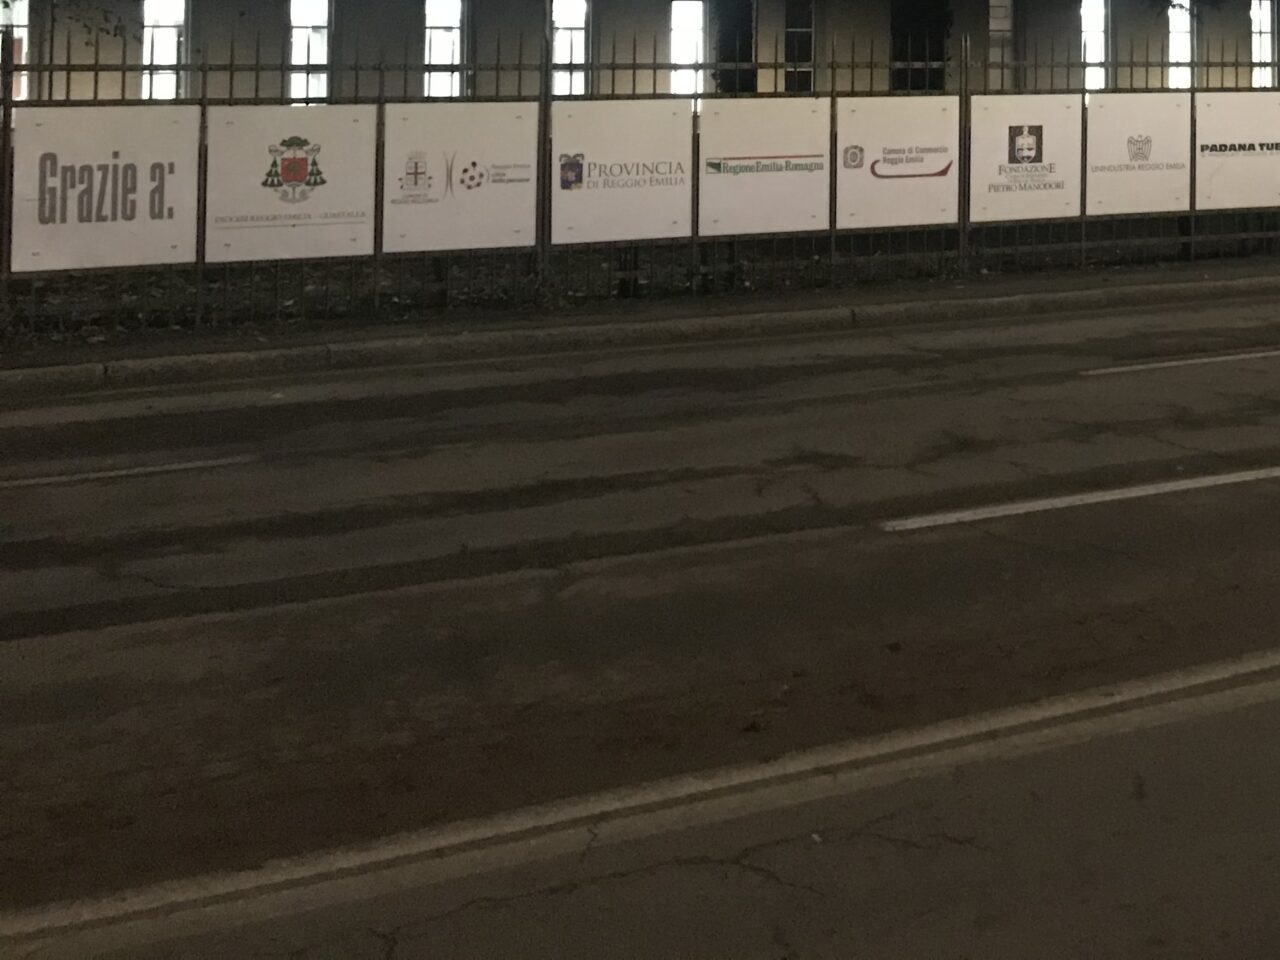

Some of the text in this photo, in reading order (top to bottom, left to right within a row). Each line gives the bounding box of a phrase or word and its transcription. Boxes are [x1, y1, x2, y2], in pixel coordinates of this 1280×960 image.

[1200, 143, 1256, 153] PADANA
[587, 161, 685, 178] PROVINCIA
[998, 162, 1056, 176] FONDAZIONE
[38, 150, 175, 225] Grazie a:
[586, 176, 686, 189] DI REGGIO EMILIA
